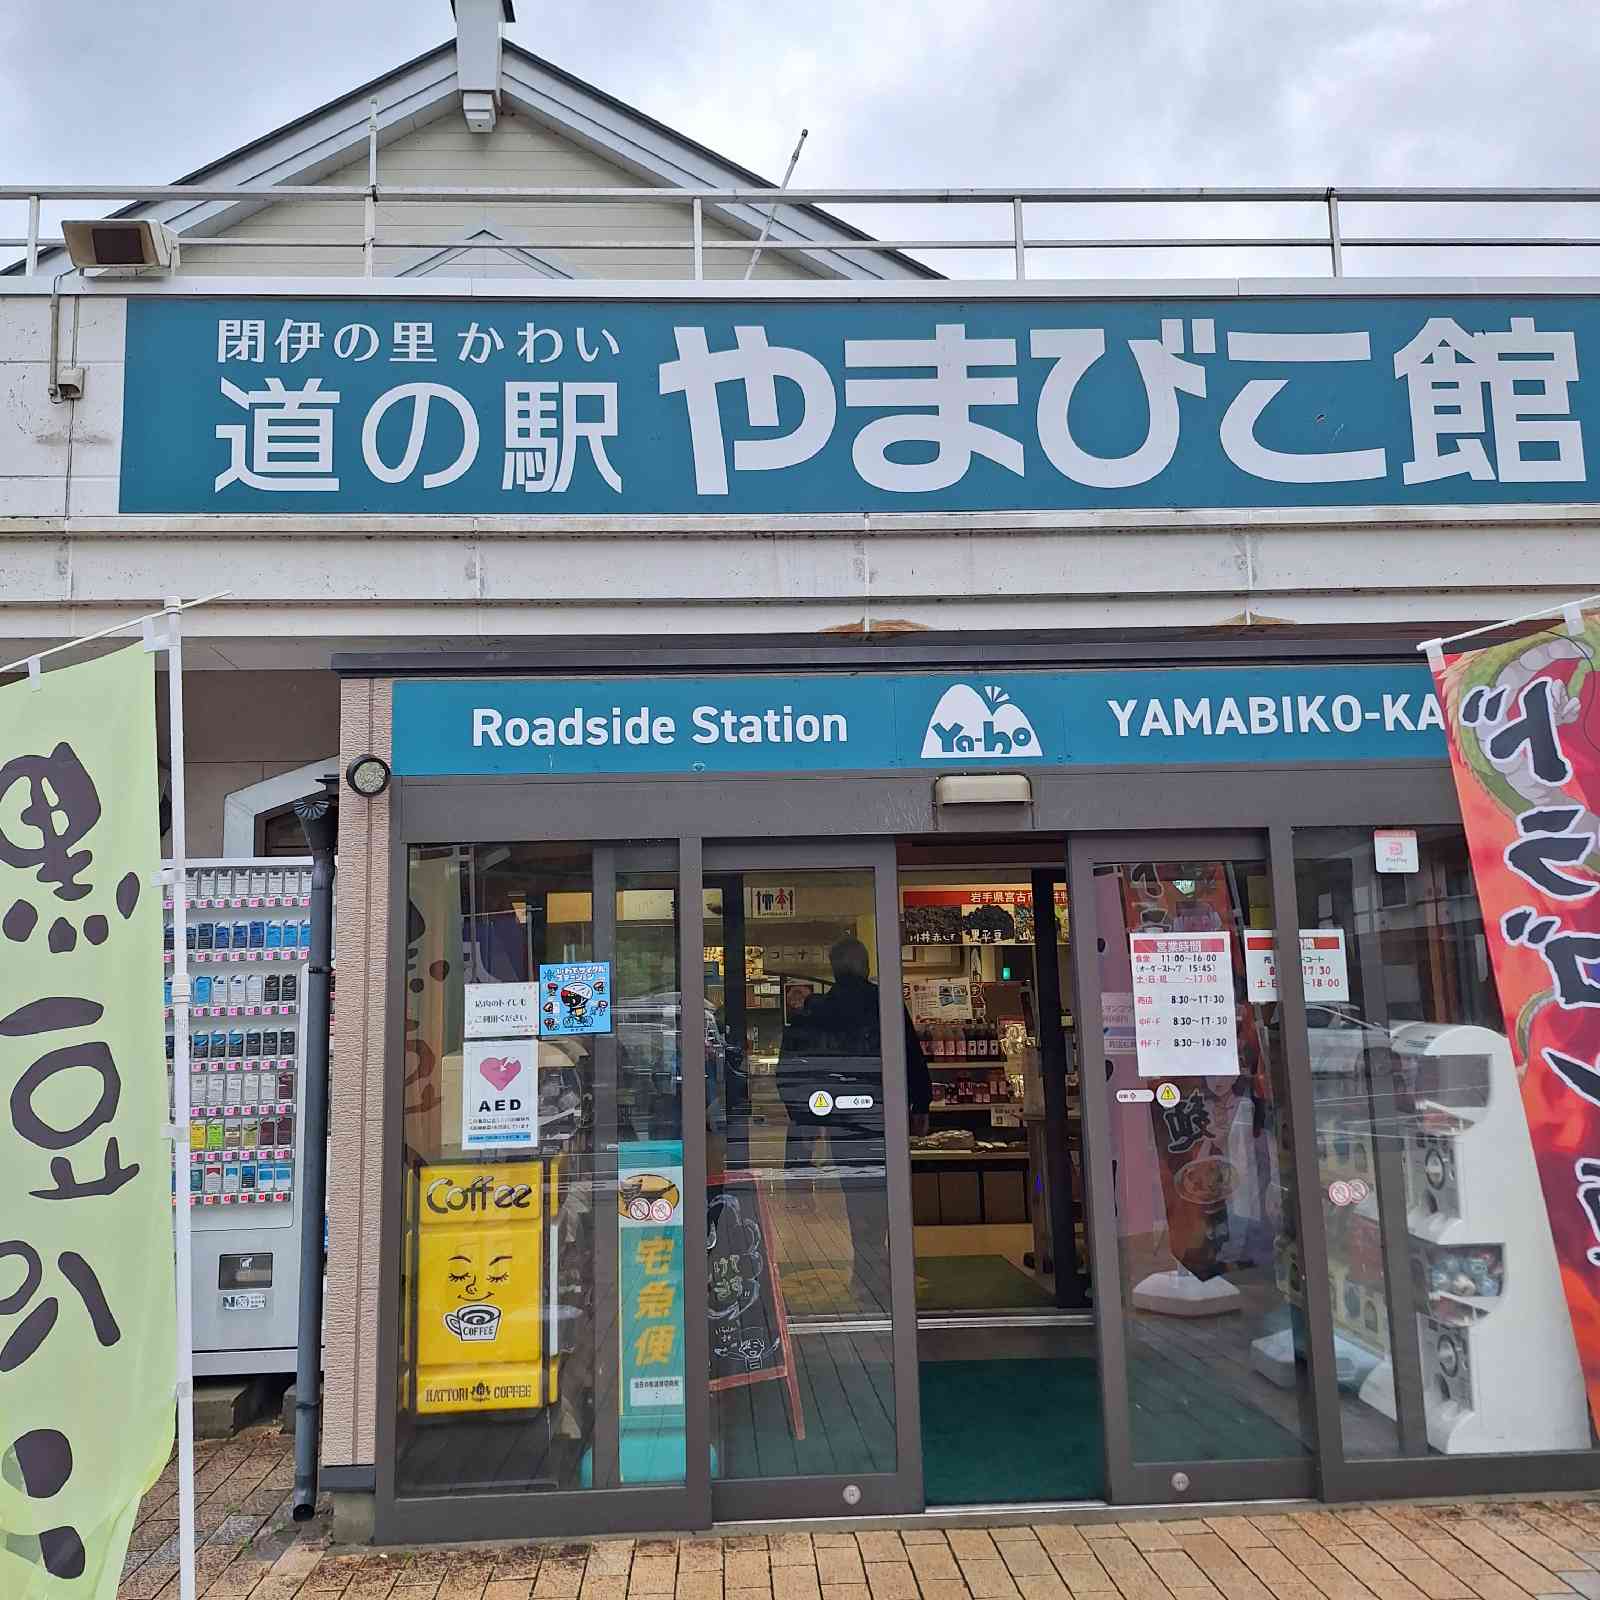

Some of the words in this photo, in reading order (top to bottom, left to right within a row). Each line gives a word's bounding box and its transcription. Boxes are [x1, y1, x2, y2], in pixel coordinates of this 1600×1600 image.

[217, 319, 437, 363] 閉伊の里
[457, 321, 621, 364] かわい
[214, 376, 623, 495] 道の駅
[659, 317, 1587, 495] やまびこ館
[472, 706, 676, 748] Roadside
[692, 704, 848, 744] Station
[1156, 940, 1202, 953] 営業時間
[477, 1098, 522, 1113] AED
[426, 1175, 533, 1214] Coffee
[634, 1236, 675, 1368] 宅急便
[462, 1324, 496, 1337] COFFEE
[425, 1387, 468, 1403] HATTORI
[494, 1384, 532, 1399] COFFEE
